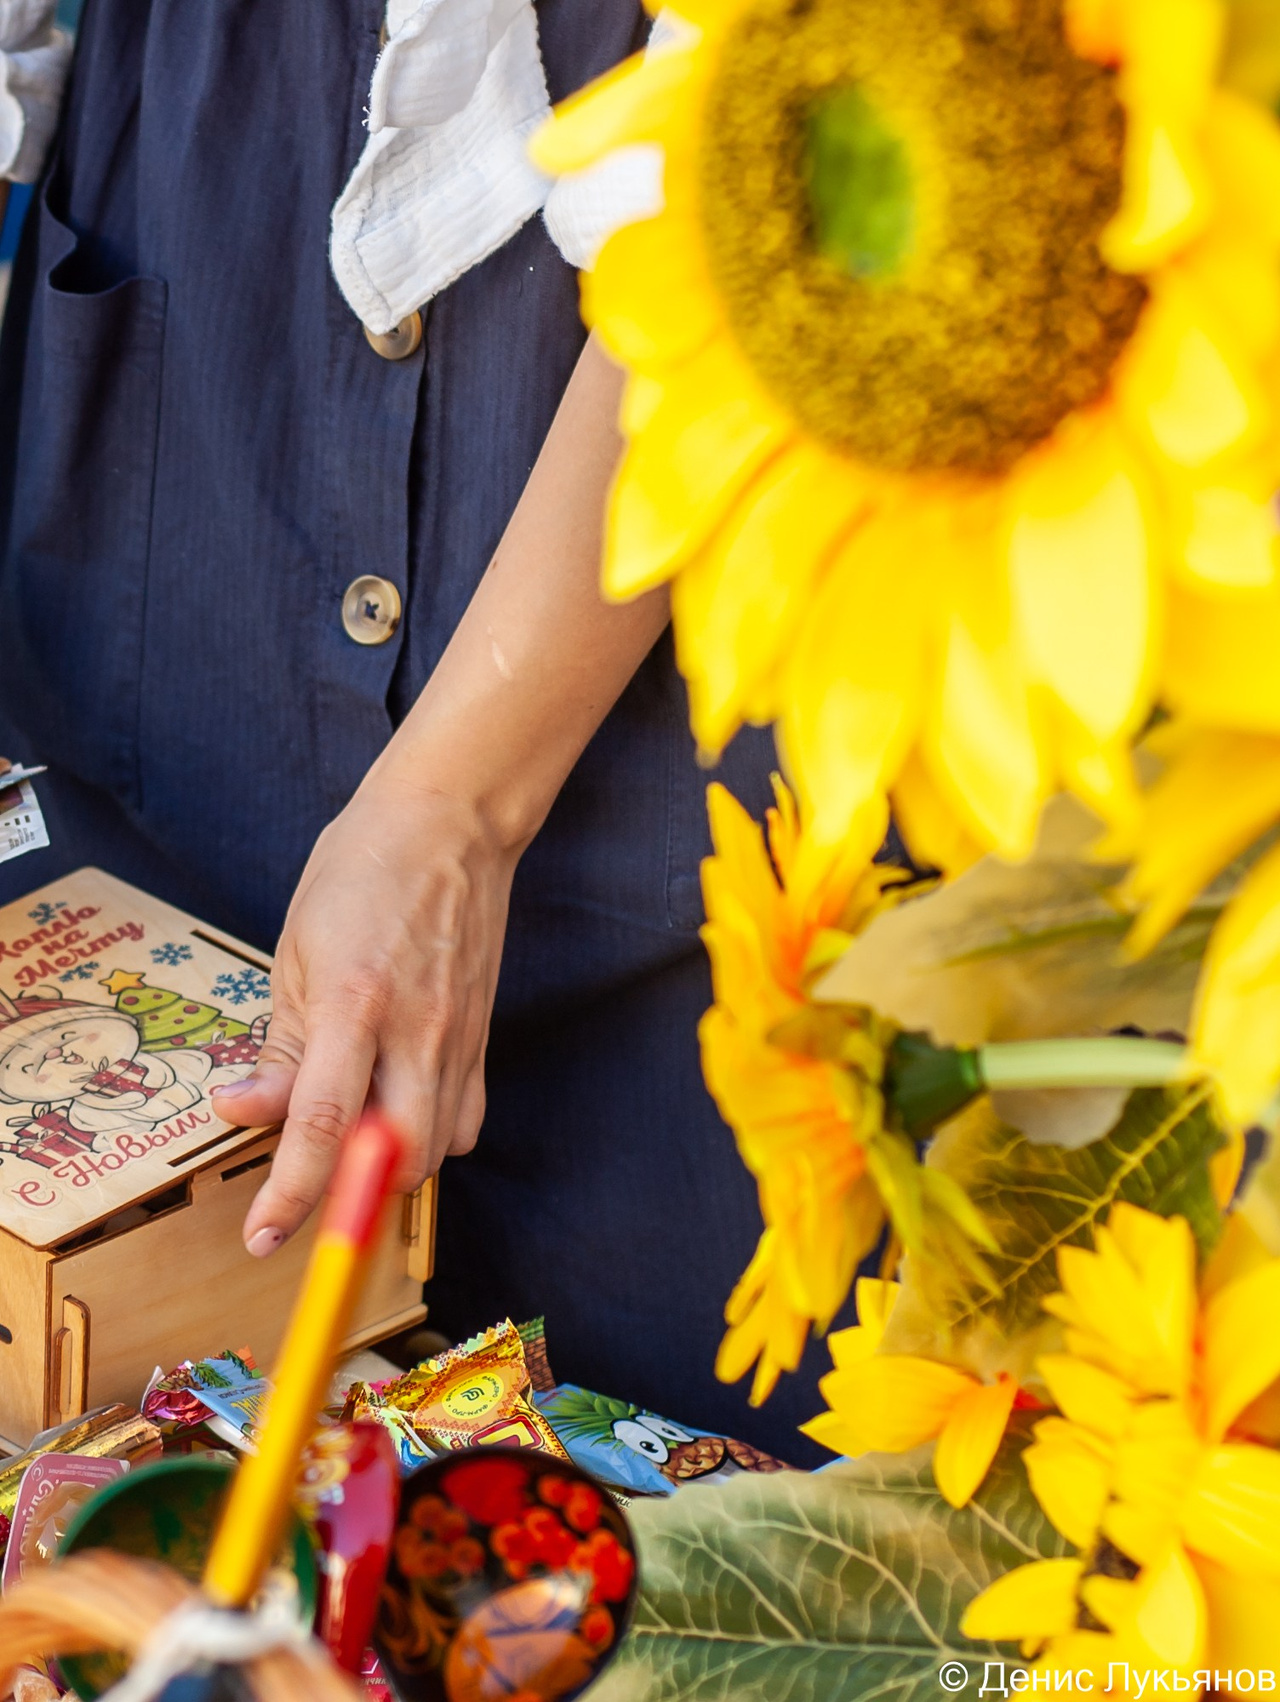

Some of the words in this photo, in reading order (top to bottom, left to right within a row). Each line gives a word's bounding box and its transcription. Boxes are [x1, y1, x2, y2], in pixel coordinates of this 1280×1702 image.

[13, 921, 144, 988] Мечту
[41, 929, 90, 956] на
[53, 1111, 211, 1188] Новым
